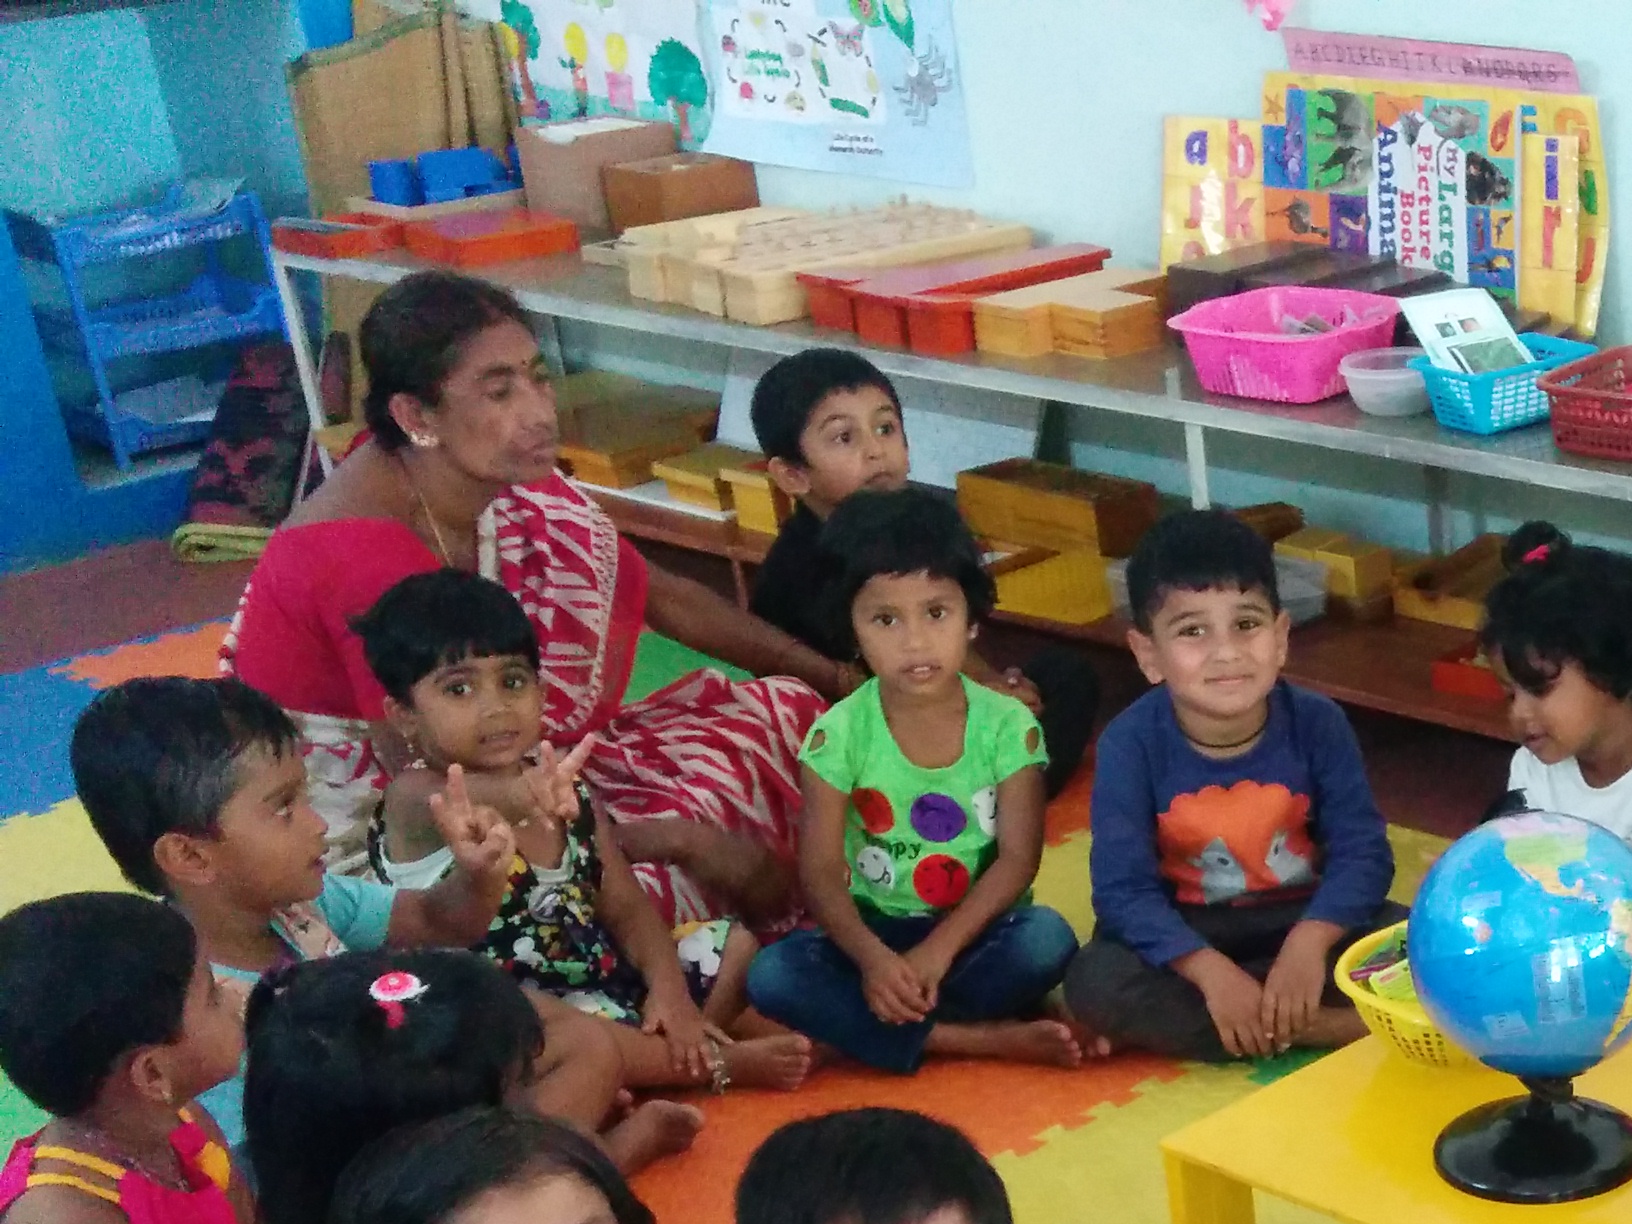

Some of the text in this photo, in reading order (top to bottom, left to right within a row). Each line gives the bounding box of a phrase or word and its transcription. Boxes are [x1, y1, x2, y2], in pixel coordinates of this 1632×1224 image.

[1443, 147, 1458, 178] My
[1400, 191, 1417, 265] Book
[1417, 144, 1434, 261] Picture
